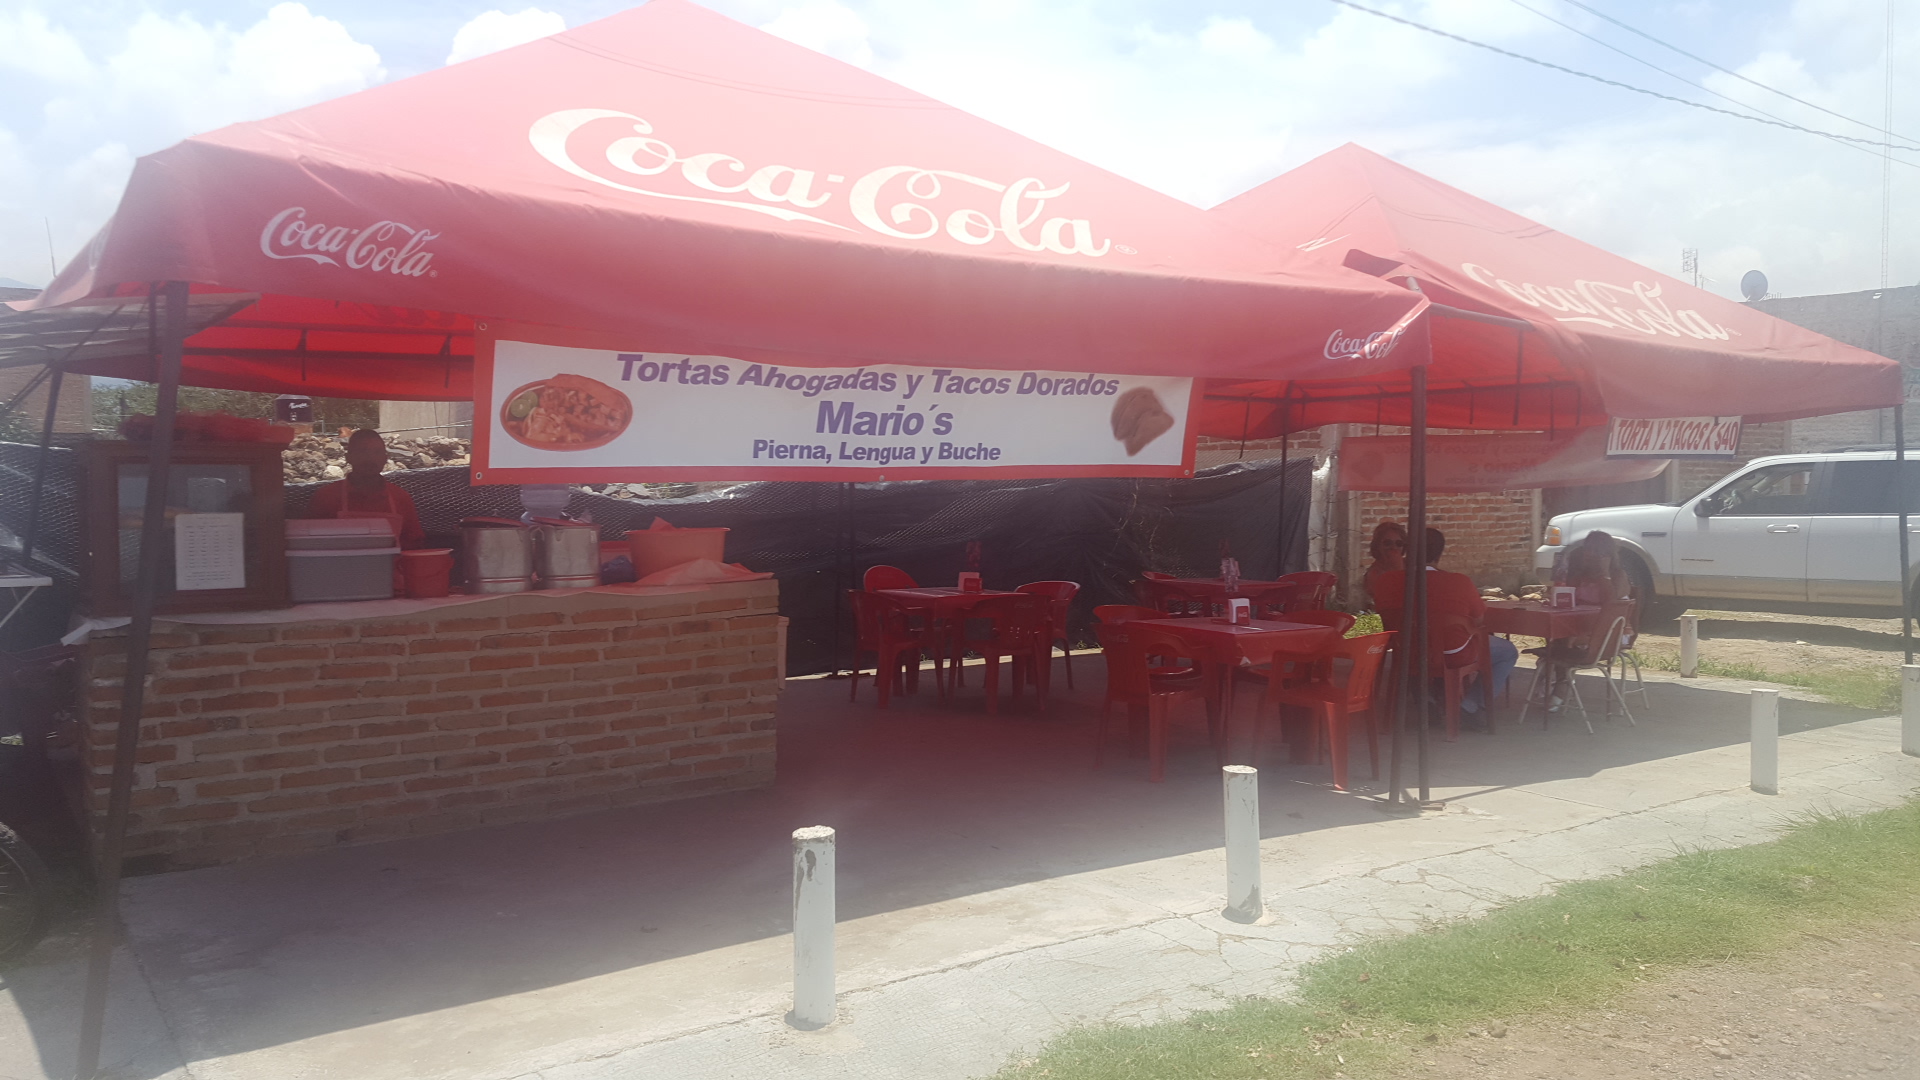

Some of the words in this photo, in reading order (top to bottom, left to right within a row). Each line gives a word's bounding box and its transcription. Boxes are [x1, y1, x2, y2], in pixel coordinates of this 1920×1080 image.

[528, 107, 1112, 258] Coca-Cola
[259, 206, 441, 278] Coca-Cola
[617, 353, 730, 386] Tortas
[736, 363, 897, 398] Ahogadas
[902, 374, 924, 400] y
[931, 368, 1011, 395] Tacos
[1016, 371, 1120, 396] Dorados
[752, 439, 832, 465] Pierna,
[838, 441, 916, 466] Lengua
[919, 446, 934, 465] y
[938, 442, 1001, 461] Buche
[1617, 420, 1654, 451] TORTA
[1651, 420, 1665, 451] Y
